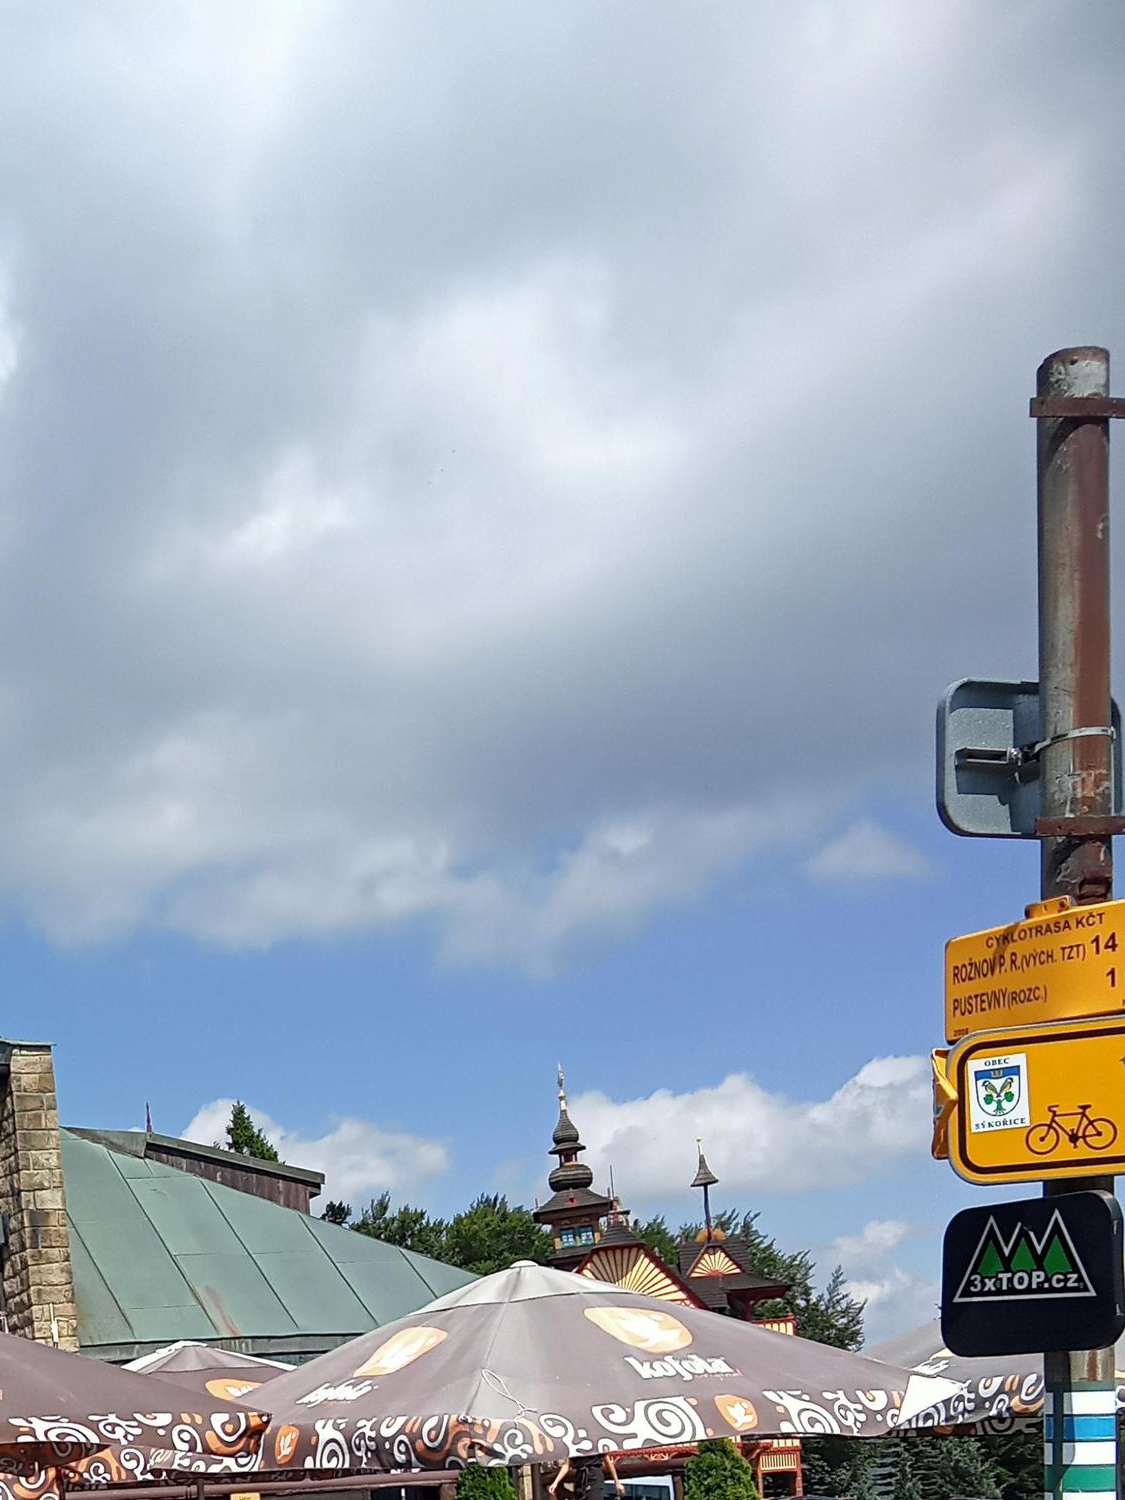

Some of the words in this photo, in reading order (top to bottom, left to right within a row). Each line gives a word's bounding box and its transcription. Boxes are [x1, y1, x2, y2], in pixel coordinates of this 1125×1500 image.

[985, 919, 1072, 949] CYKLOTRASA
[1075, 912, 1106, 930] KČT
[952, 955, 997, 986] ROŽNOV
[1060, 943, 1087, 962] TZT)
[1090, 931, 1119, 955] 14
[1105, 967, 1116, 988] 1
[984, 1057, 1010, 1067] OBEC
[969, 1270, 1079, 1293] 3xTOP.cz
[624, 1354, 735, 1381] kofola
